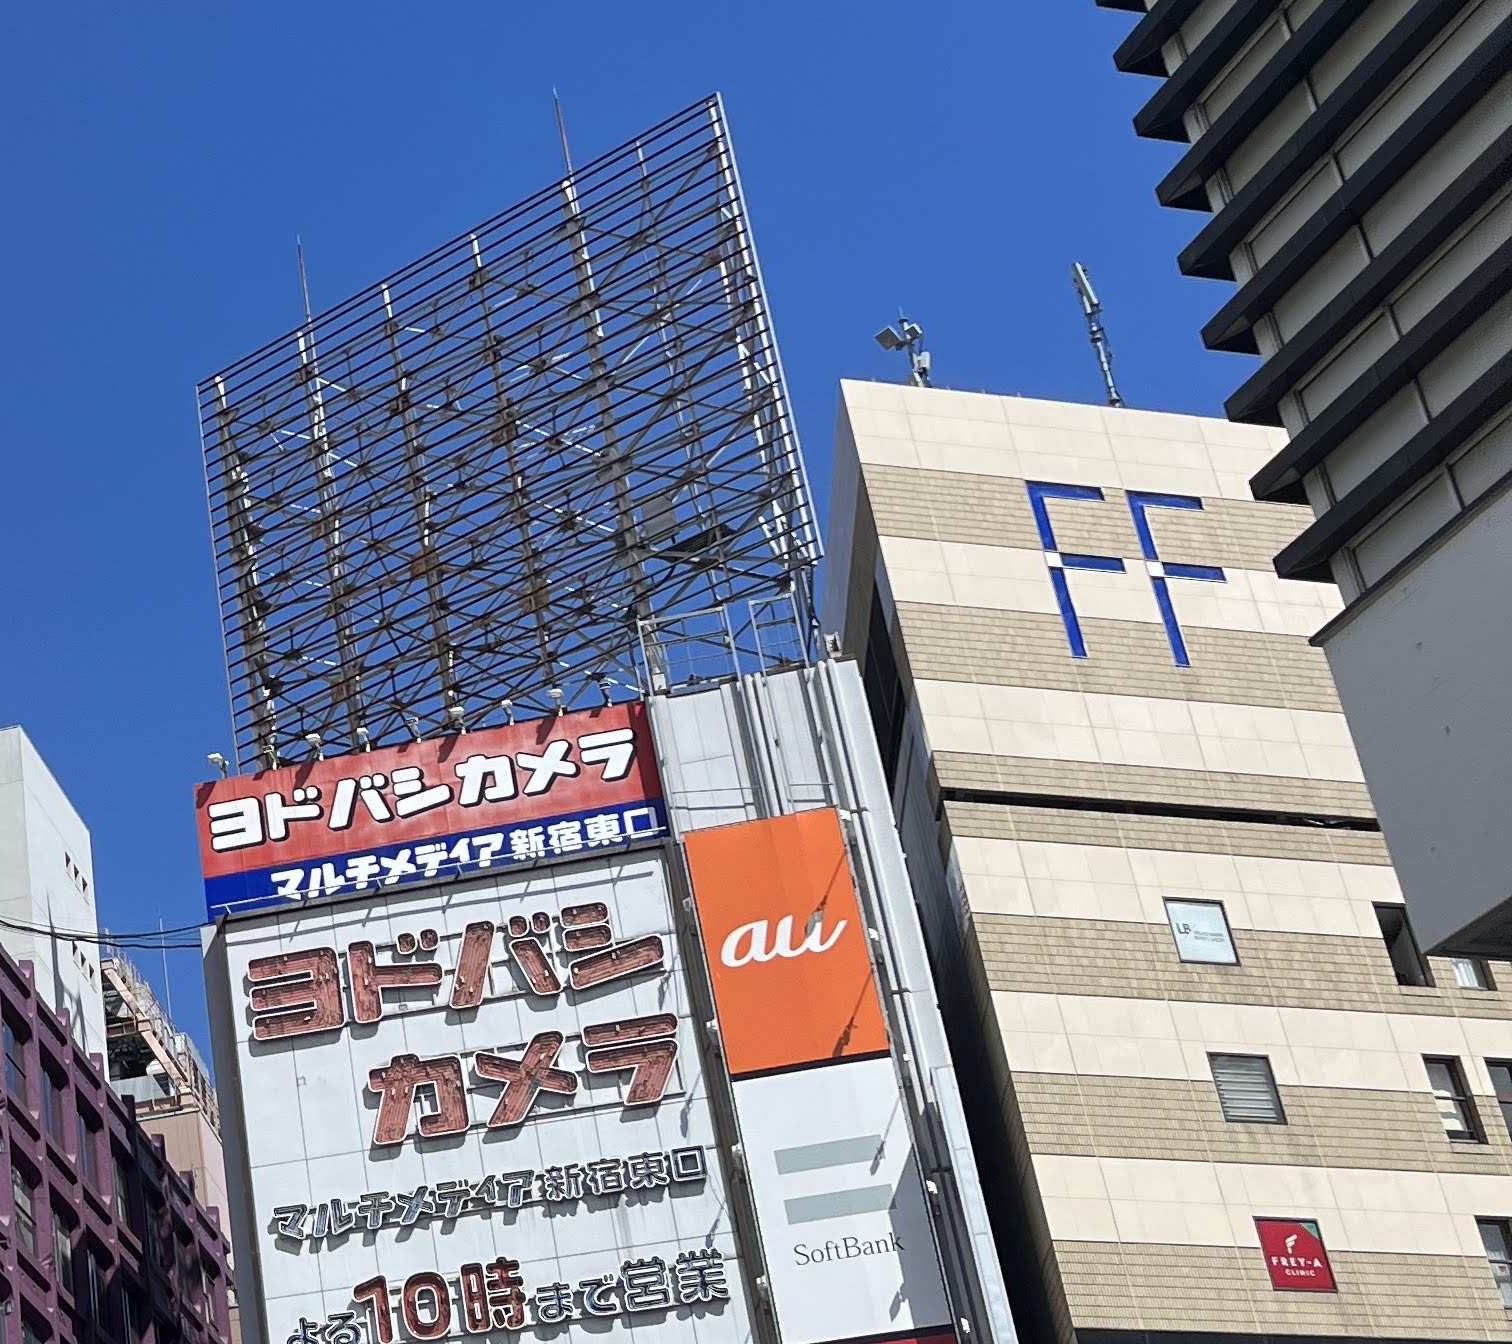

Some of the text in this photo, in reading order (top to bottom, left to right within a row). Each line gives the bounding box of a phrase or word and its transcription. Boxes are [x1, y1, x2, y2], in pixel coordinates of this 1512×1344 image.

[207, 727, 636, 854] ヨドバシカメラ
[271, 806, 657, 900] マルチメディア新宿東口
[248, 901, 665, 1040] ヨドバシ
[721, 914, 848, 967] au
[368, 1013, 680, 1146] カメラ
[274, 1145, 709, 1240] マルチメディア新宿東口
[793, 1231, 906, 1266] SoftBank
